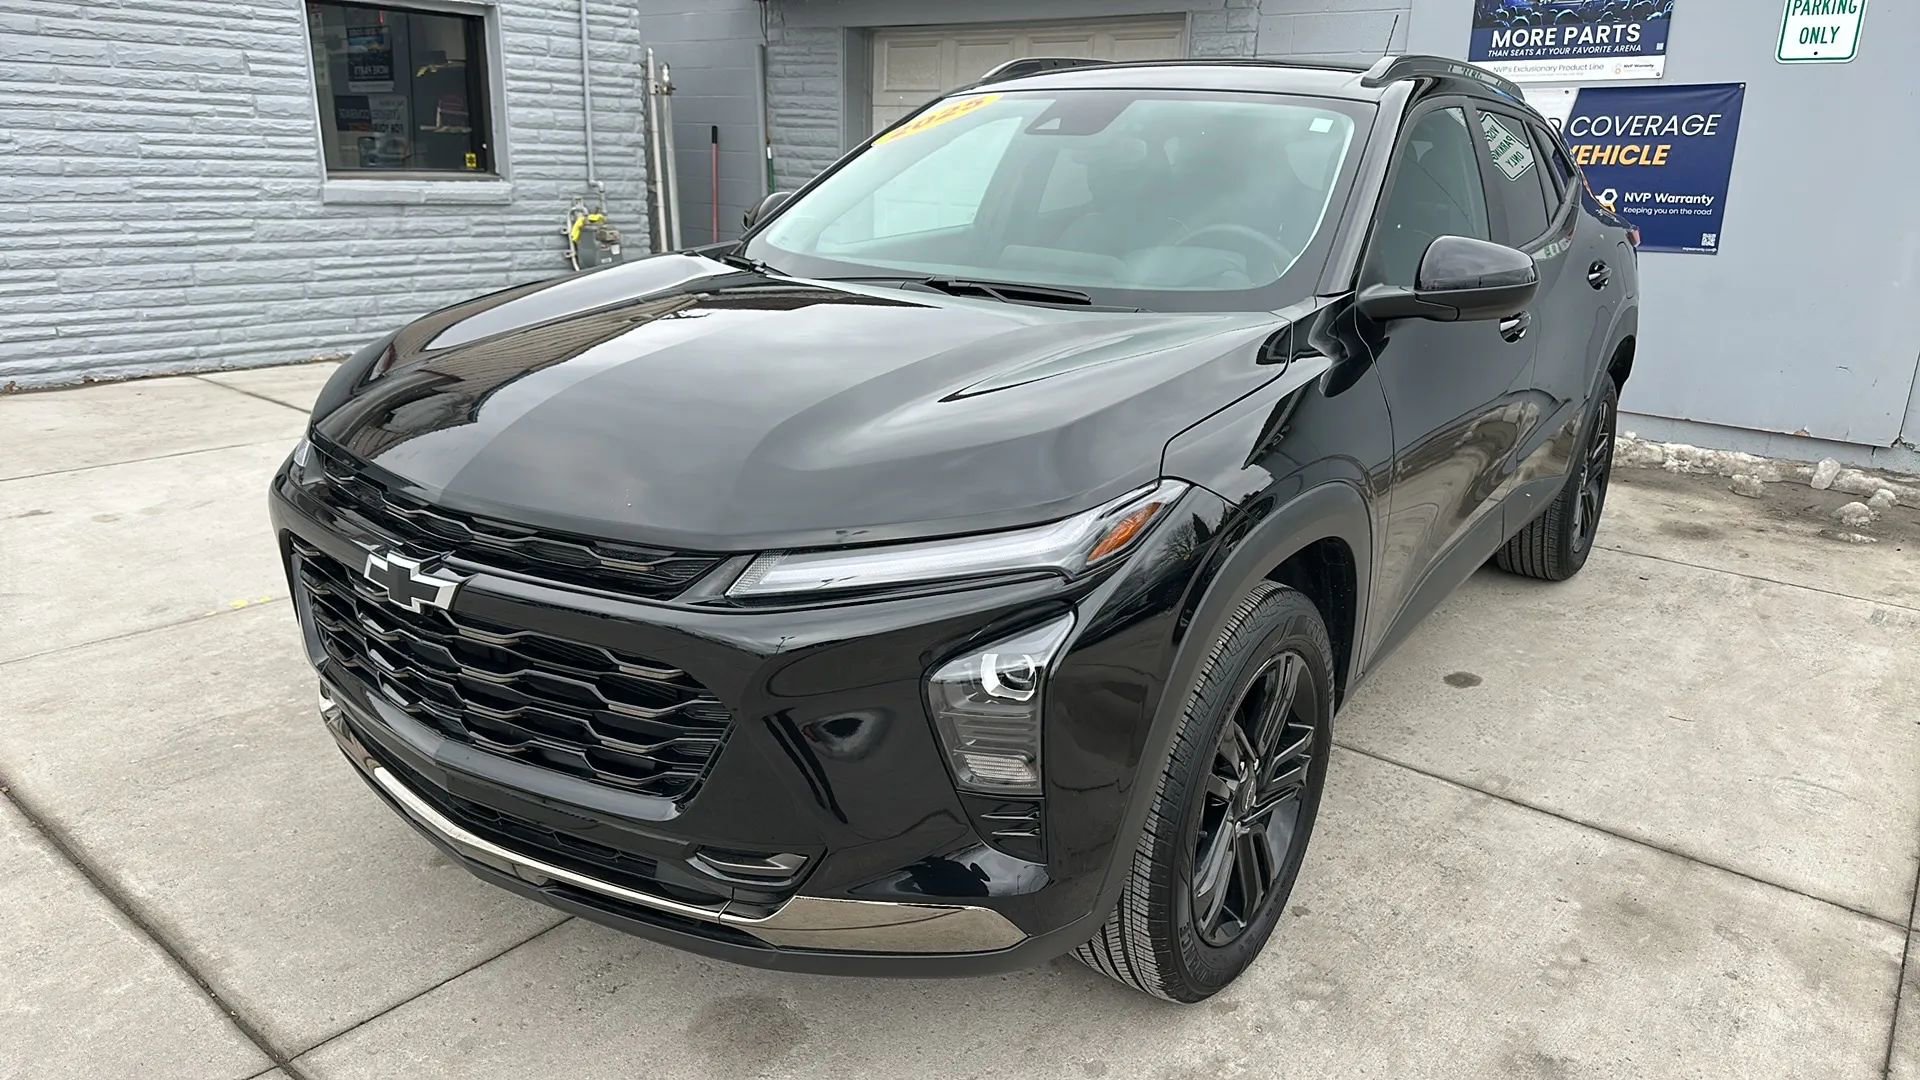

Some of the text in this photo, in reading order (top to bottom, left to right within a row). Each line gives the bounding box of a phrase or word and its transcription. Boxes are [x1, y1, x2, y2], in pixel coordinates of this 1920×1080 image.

[1792, 0, 1857, 16] PARKING
[1491, 23, 1641, 48] MORE PARTS
[1799, 26, 1840, 44] ONLY
[1510, 48, 1534, 57] SEATS
[1535, 48, 1547, 56] AT
[1548, 47, 1570, 55] YOUR
[1572, 45, 1612, 54] FAVORITE
[1613, 44, 1641, 53] ARENA
[1513, 65, 1556, 73] Exclusionary
[1570, 114, 1722, 137] COVERAGE
[1624, 193, 1714, 206] NVP Warranty
[1623, 207, 1652, 215] Keeping
